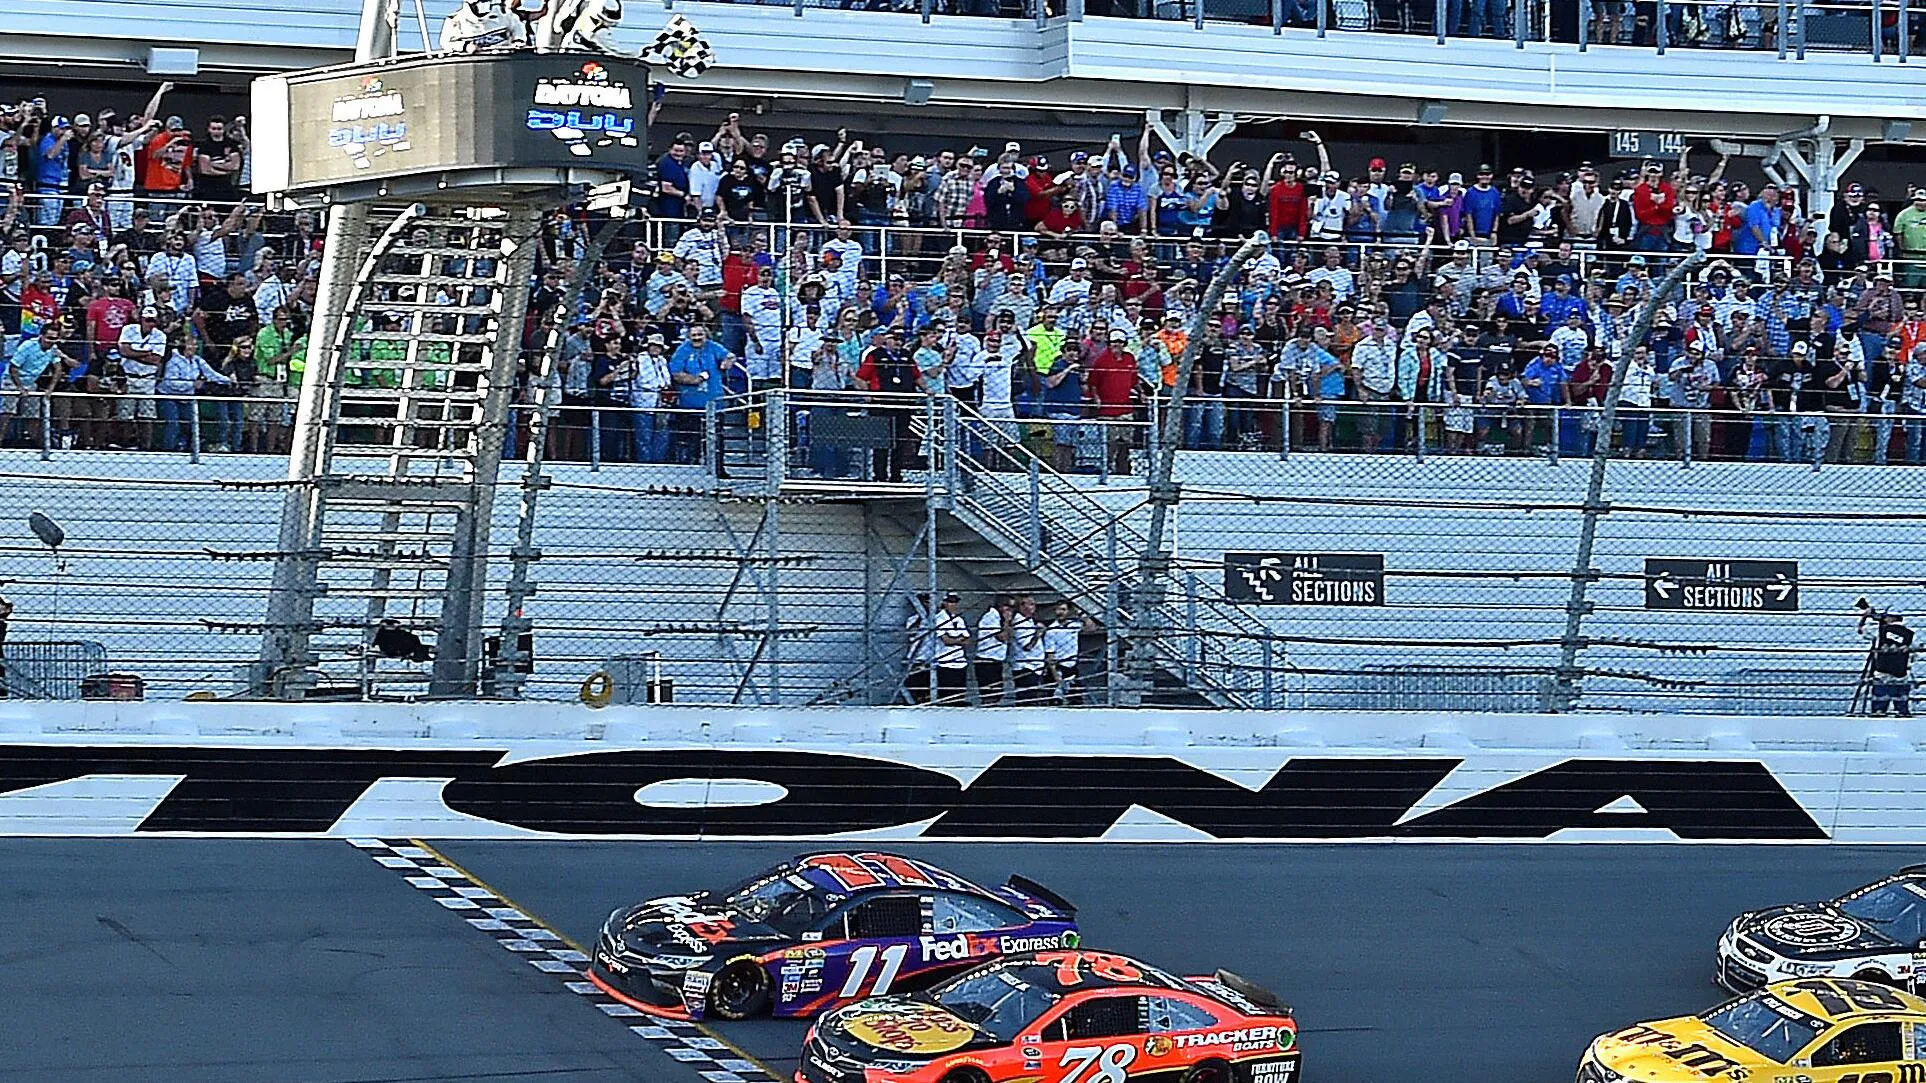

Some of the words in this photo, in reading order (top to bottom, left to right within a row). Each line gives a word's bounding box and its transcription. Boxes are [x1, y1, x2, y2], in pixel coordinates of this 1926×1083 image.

[534, 84, 633, 108] DAYTONA
[1615, 132, 1640, 153] 145
[1658, 133, 1682, 154] 144
[1292, 580, 1375, 602] SECTIONS
[1683, 586, 1764, 608] SECTIONS
[0, 745, 1830, 839] TONA
[799, 853, 938, 893] 11
[919, 933, 1000, 962] FedEx
[1000, 935, 1059, 954] Express
[838, 943, 909, 999] 11
[1034, 951, 1143, 987] 78
[1173, 1026, 1278, 1049] TRACKER
[1232, 1040, 1276, 1053] BOATS
[810, 1056, 845, 1078] CAMRY
[1058, 1042, 1137, 1083] 78
